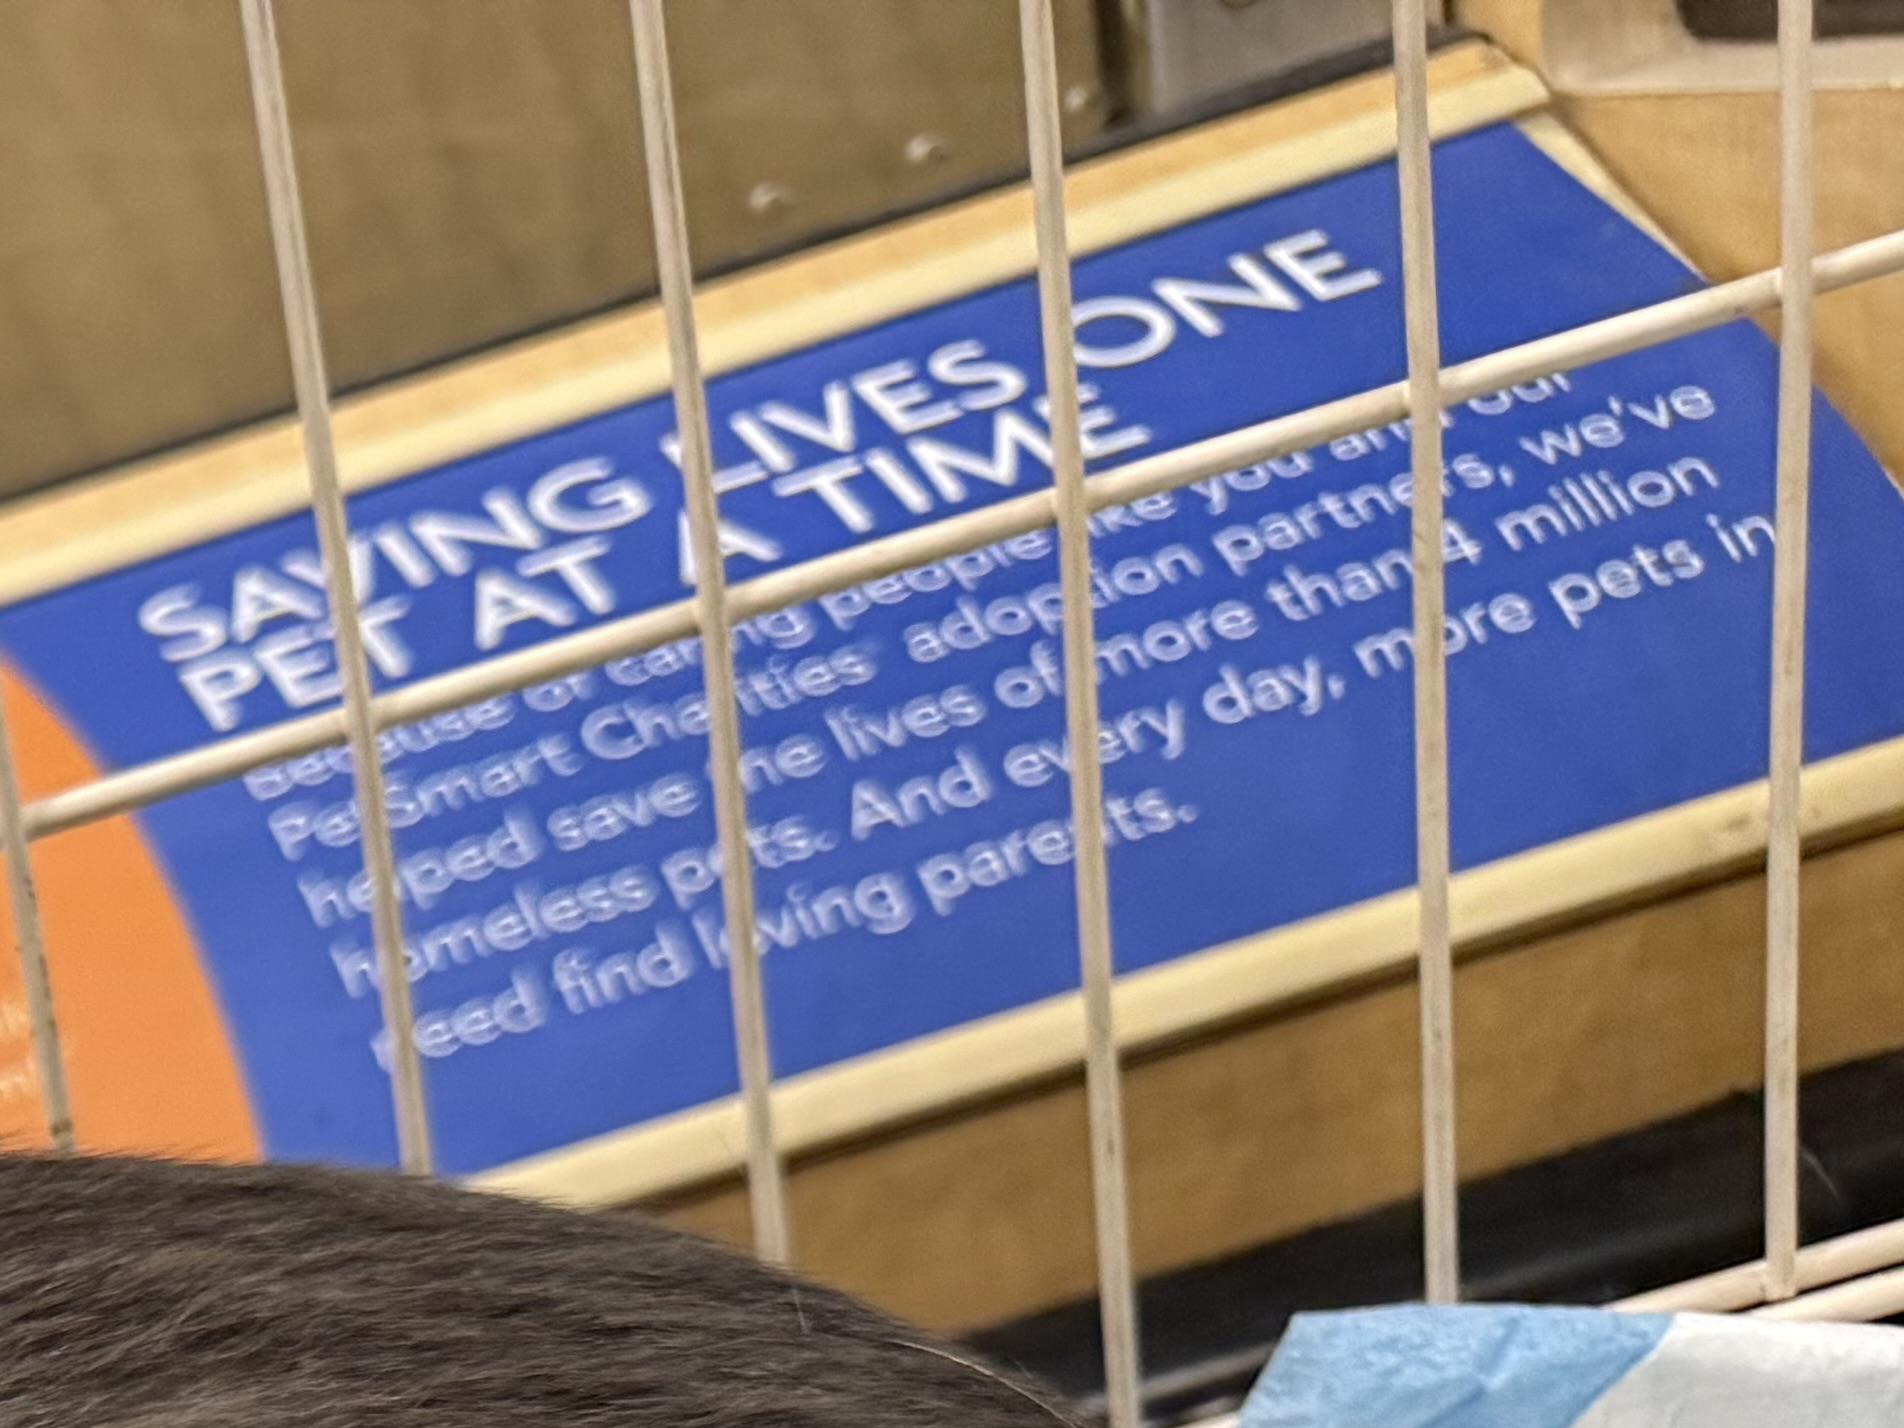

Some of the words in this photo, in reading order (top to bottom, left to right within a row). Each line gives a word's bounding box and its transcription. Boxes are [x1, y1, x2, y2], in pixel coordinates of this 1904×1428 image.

[138, 456, 653, 663] SAVING
[1064, 228, 1384, 369] ONE
[604, 607, 814, 686] carng
[1330, 410, 1454, 462] an
[178, 593, 414, 733] PET
[475, 533, 622, 652] AT
[267, 734, 585, 862] PeSmart
[581, 645, 878, 761] Chaities
[903, 544, 1204, 663] adopion
[1519, 385, 1716, 466] we've
[297, 806, 544, 928] heped
[546, 772, 701, 852] save
[705, 734, 827, 795] he
[824, 684, 989, 761] lives
[994, 640, 1063, 709] of
[1092, 600, 1259, 684] more
[1265, 546, 1415, 622] than
[1439, 516, 1483, 566] 4
[1494, 454, 1720, 551] million
[850, 745, 994, 841] And
[1003, 698, 1187, 788] every
[1201, 655, 1345, 726] day,
[1352, 592, 1537, 679] more
[1548, 536, 1706, 629] pets
[1706, 513, 1776, 564] in
[552, 917, 693, 1016] find
[916, 787, 1200, 918] parets.
